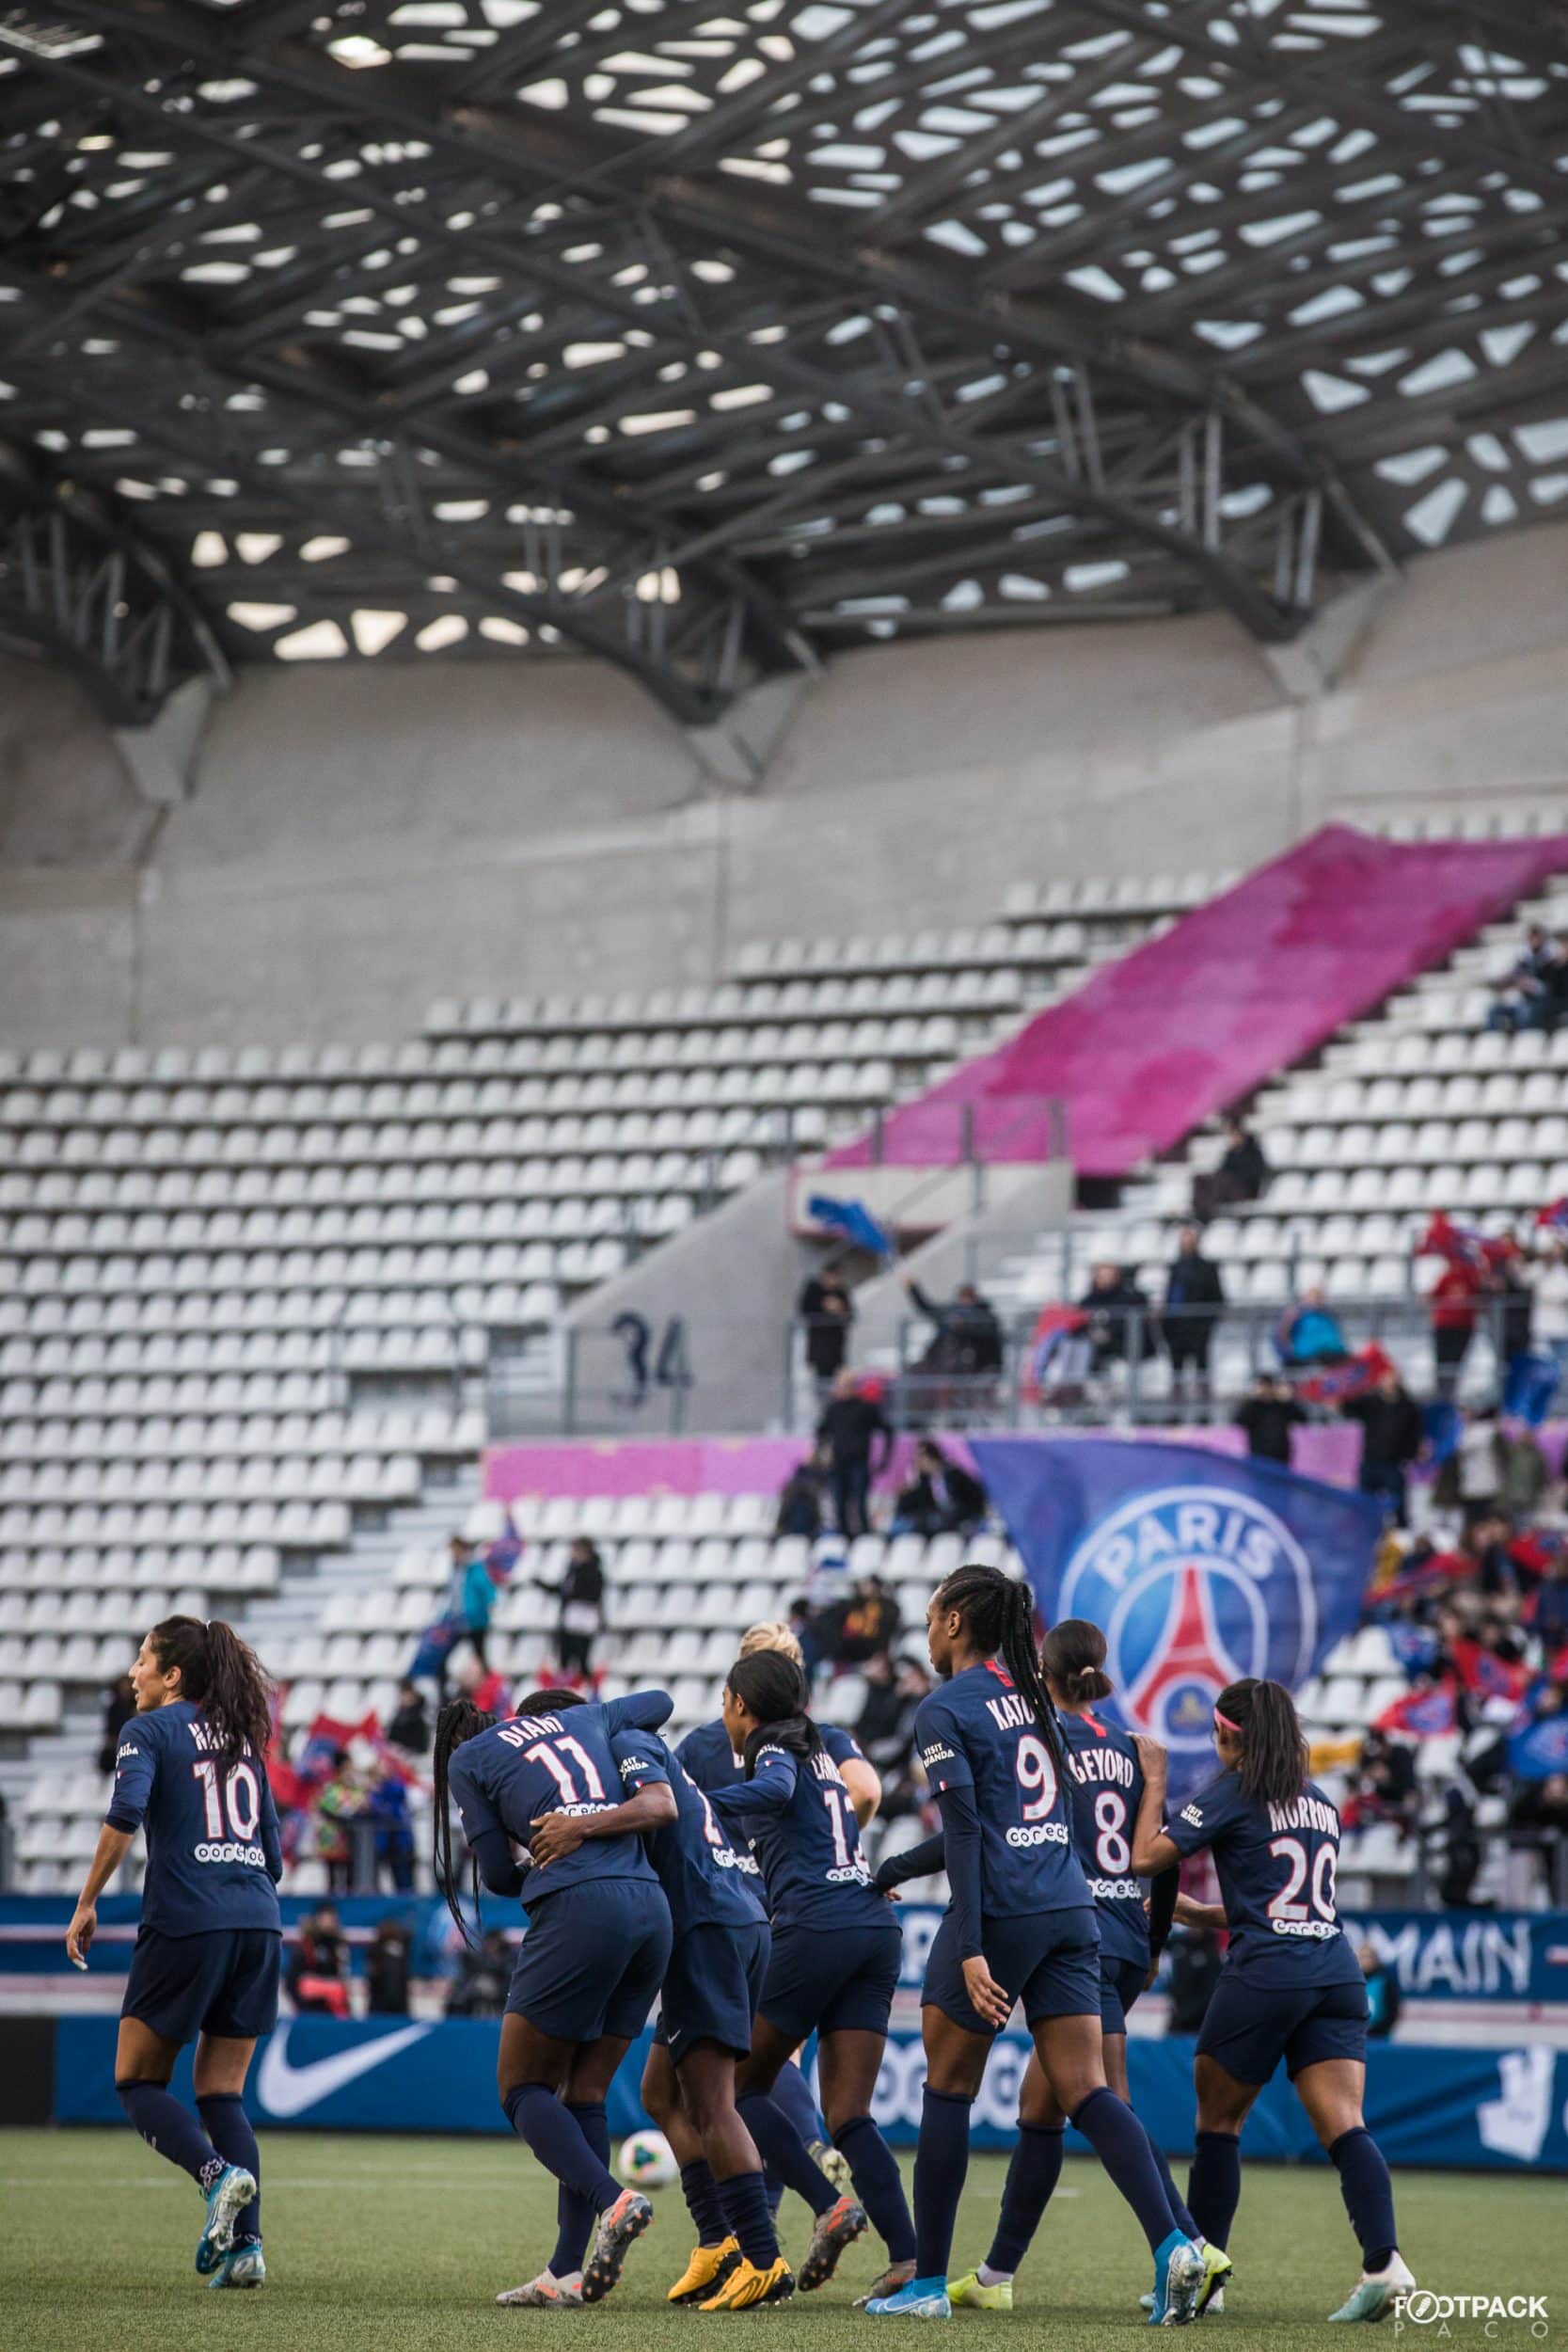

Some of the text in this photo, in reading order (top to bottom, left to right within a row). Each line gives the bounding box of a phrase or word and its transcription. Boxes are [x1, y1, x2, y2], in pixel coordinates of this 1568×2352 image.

[1094, 1505, 1278, 1590] PARIS
[193, 1759, 260, 1841] 10
[524, 1735, 606, 1804] 11
[1016, 1735, 1057, 1821] 9
[1068, 1748, 1134, 1788] GEYORO
[1094, 1791, 1131, 1874] 8
[1267, 1796, 1339, 1839] MORRONI
[1267, 1836, 1338, 1923] 20
